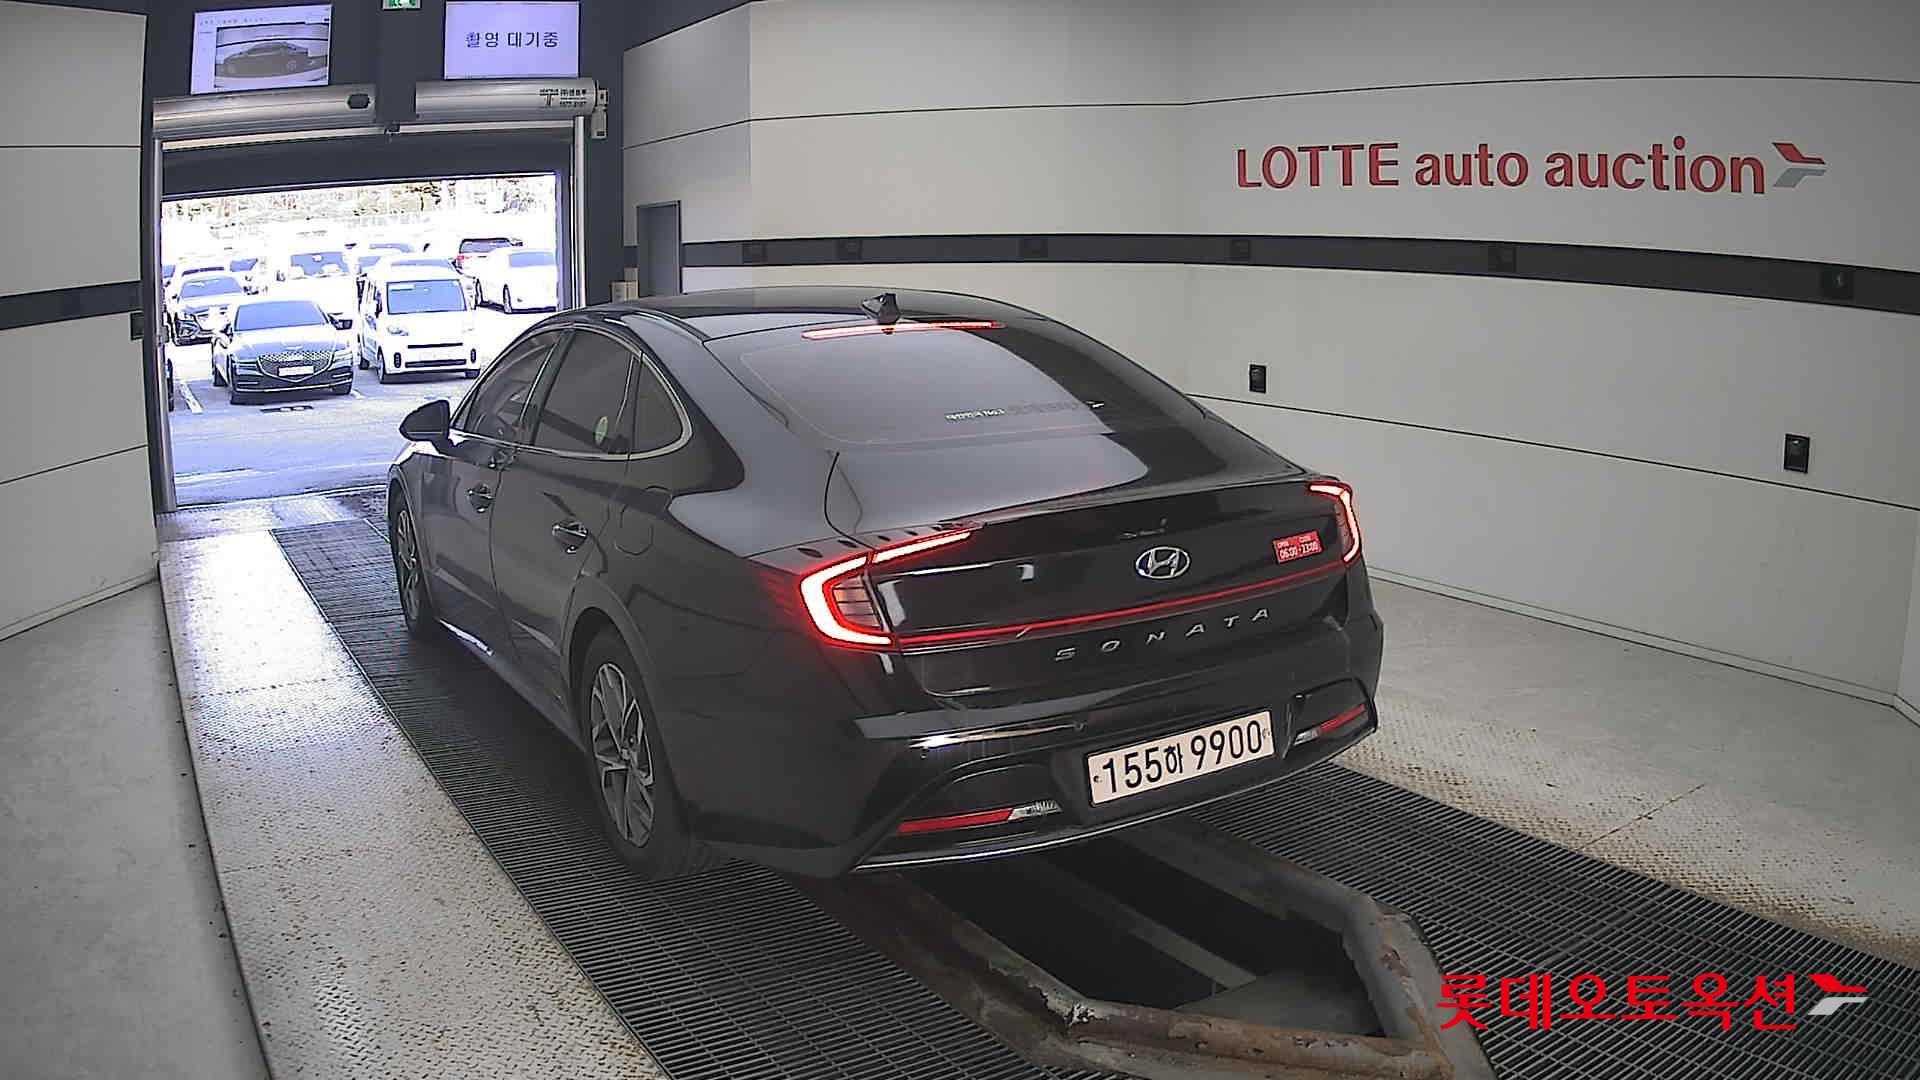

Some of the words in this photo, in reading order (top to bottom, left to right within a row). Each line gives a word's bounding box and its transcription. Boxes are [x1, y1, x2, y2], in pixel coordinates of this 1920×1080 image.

[507, 31, 559, 48] 대기중
[1236, 142, 1399, 188] LOTTE
[1415, 143, 1529, 187] auto
[1544, 135, 1766, 195] auction
[1053, 607, 1271, 662] SONATA
[1102, 742, 1184, 794] 155하
[1190, 720, 1263, 770] 9900
